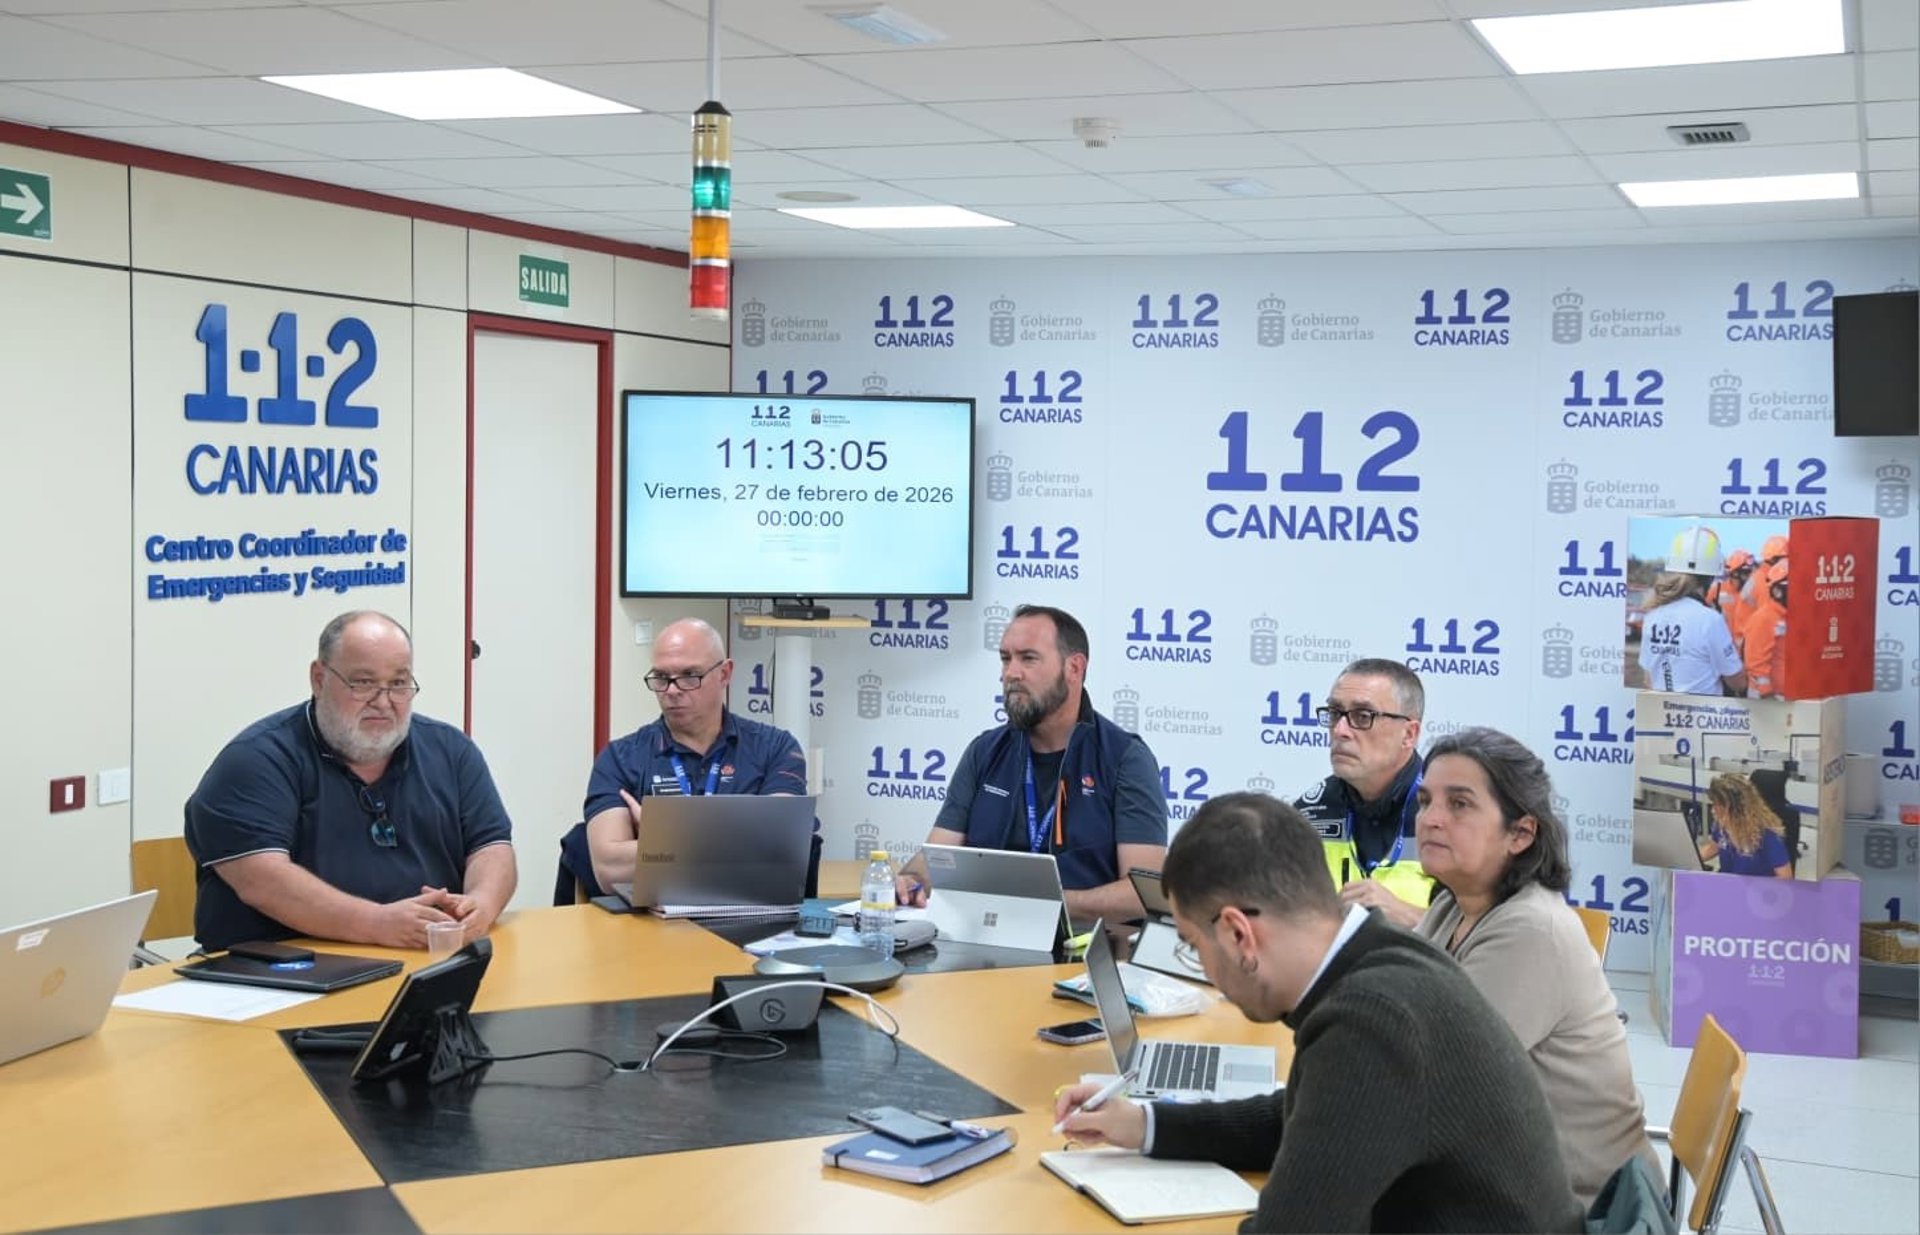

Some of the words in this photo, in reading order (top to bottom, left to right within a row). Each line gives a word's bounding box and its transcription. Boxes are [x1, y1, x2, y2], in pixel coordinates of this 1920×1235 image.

[521, 266, 567, 296] SALIDA
[1415, 288, 1509, 324] 112
[1727, 280, 1834, 319] 112
[875, 295, 953, 328] 112
[1133, 294, 1218, 328] 112
[1292, 313, 1359, 325] Gobierno
[1590, 309, 1665, 322] Gobierno
[771, 316, 827, 328] Gobierno
[1021, 315, 1082, 326] Gobierno
[771, 330, 784, 341] de
[787, 331, 840, 341] Canarias
[1020, 329, 1035, 340] de
[1038, 329, 1095, 340] Canarias
[1291, 328, 1307, 340] de
[1311, 328, 1374, 340] Canarias
[1415, 329, 1509, 345] CANARIAS
[1589, 325, 1607, 337] de
[1611, 323, 1681, 337] Canarias
[1726, 323, 1833, 341] CANARIAS
[875, 333, 953, 347] CANARIAS
[1133, 333, 1218, 348] CANARIAS
[1000, 371, 1082, 403] 112
[1564, 370, 1663, 406] 112
[1748, 391, 1829, 406] Gobierno
[751, 405, 791, 419] 112
[1000, 408, 1081, 423] CANARIAS
[1563, 412, 1662, 427] CANARIAS
[1748, 407, 1768, 421] de
[717, 438, 887, 471] 11:13:05
[1207, 411, 1419, 492] 112
[186, 444, 377, 495] CANARIAS
[1018, 471, 1079, 483] Gobierno
[1721, 458, 1827, 494] 112
[644, 482, 727, 502] Viernes,
[735, 484, 759, 500] 27
[766, 485, 790, 500] de
[798, 485, 867, 501] febrero
[875, 487, 898, 502] de
[905, 487, 953, 502] 2026
[1017, 485, 1032, 496] de
[1035, 485, 1092, 497] Canarias
[1584, 480, 1659, 493] Gobierno
[1584, 495, 1602, 508] de
[1605, 496, 1675, 508] Canarias
[1720, 500, 1827, 516] CANARIAS
[758, 510, 843, 527] 00:00:00
[1206, 504, 1418, 542] CANARIAS
[145, 532, 234, 563] Centro
[239, 529, 377, 560] Coordinador
[380, 528, 407, 552] de
[997, 526, 1078, 559] 112
[1559, 540, 1622, 576] 11
[997, 563, 1078, 579] CANARIAS
[147, 567, 291, 602] Emergencias
[294, 569, 308, 596] y
[311, 560, 405, 592] Seguridad
[1559, 581, 1627, 598] CANAR
[1815, 587, 1855, 601] CANARIAS
[870, 598, 949, 629] 112
[1127, 608, 1211, 643] 112
[869, 632, 949, 649] CANARIAS
[1284, 634, 1351, 649] Gobierno
[1406, 618, 1499, 654] 112
[1126, 646, 1211, 663] CANARIAS
[1284, 649, 1300, 661] de
[1405, 656, 1500, 676] CANARIAS
[1580, 661, 1598, 674] de
[887, 689, 946, 704] Gobierno
[887, 704, 901, 714] de
[904, 704, 958, 718] Canarias
[1145, 706, 1208, 720] Gobierno
[1261, 691, 1318, 726] 11
[1145, 720, 1162, 734] de
[1163, 721, 1222, 735] Canarias
[1696, 715, 1750, 730] CANARIAS
[1260, 729, 1332, 747] CANARI
[867, 746, 946, 781] 112
[867, 782, 946, 801] CANARIAS
[1160, 766, 1208, 800] 12
[1576, 829, 1594, 841] de
[1609, 917, 1649, 935] RIAS
[1684, 934, 1850, 965] PROTECCIÓN
